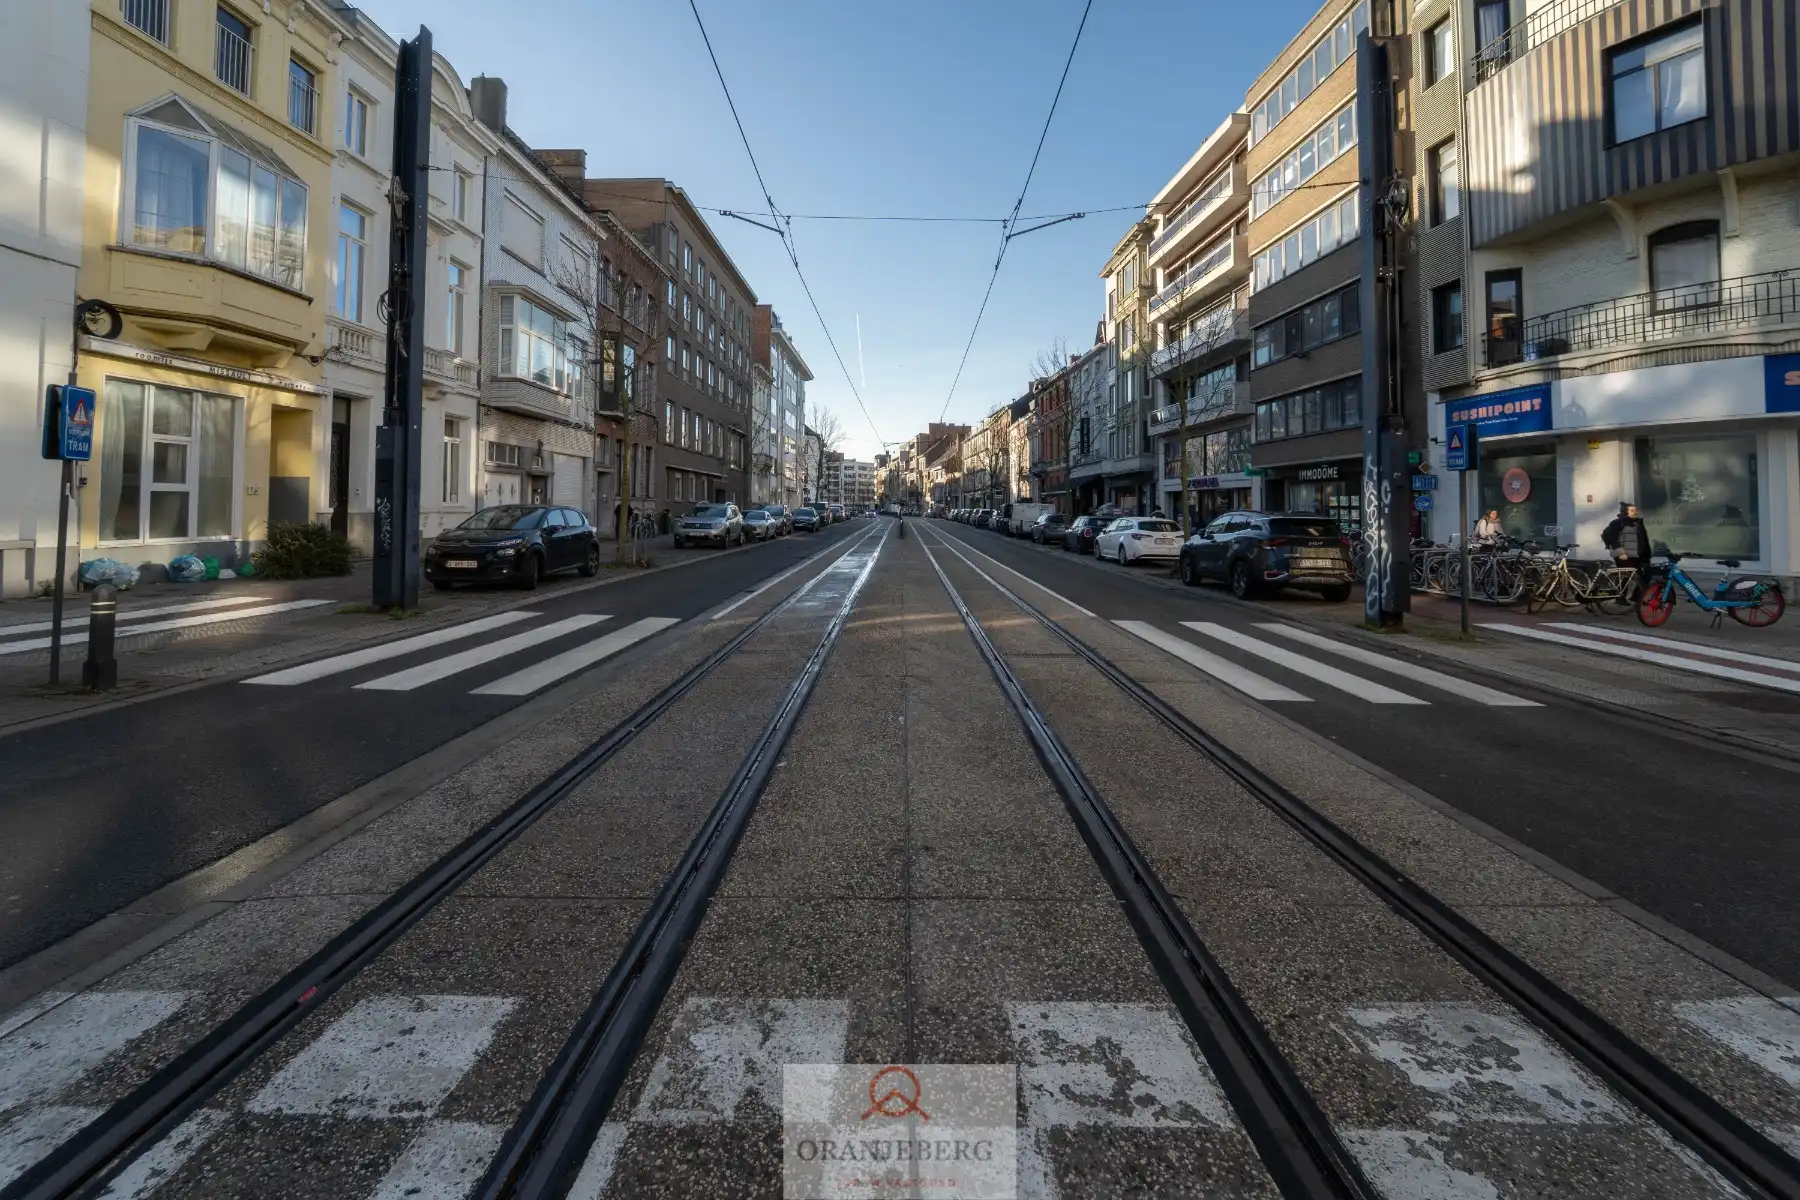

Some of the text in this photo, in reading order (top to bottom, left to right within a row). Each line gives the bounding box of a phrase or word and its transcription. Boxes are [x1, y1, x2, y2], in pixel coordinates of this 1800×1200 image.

[208, 366, 252, 381] MISSAULT
[1451, 398, 1542, 422] SUSHIPOINT
[68, 440, 89, 452] TRAM
